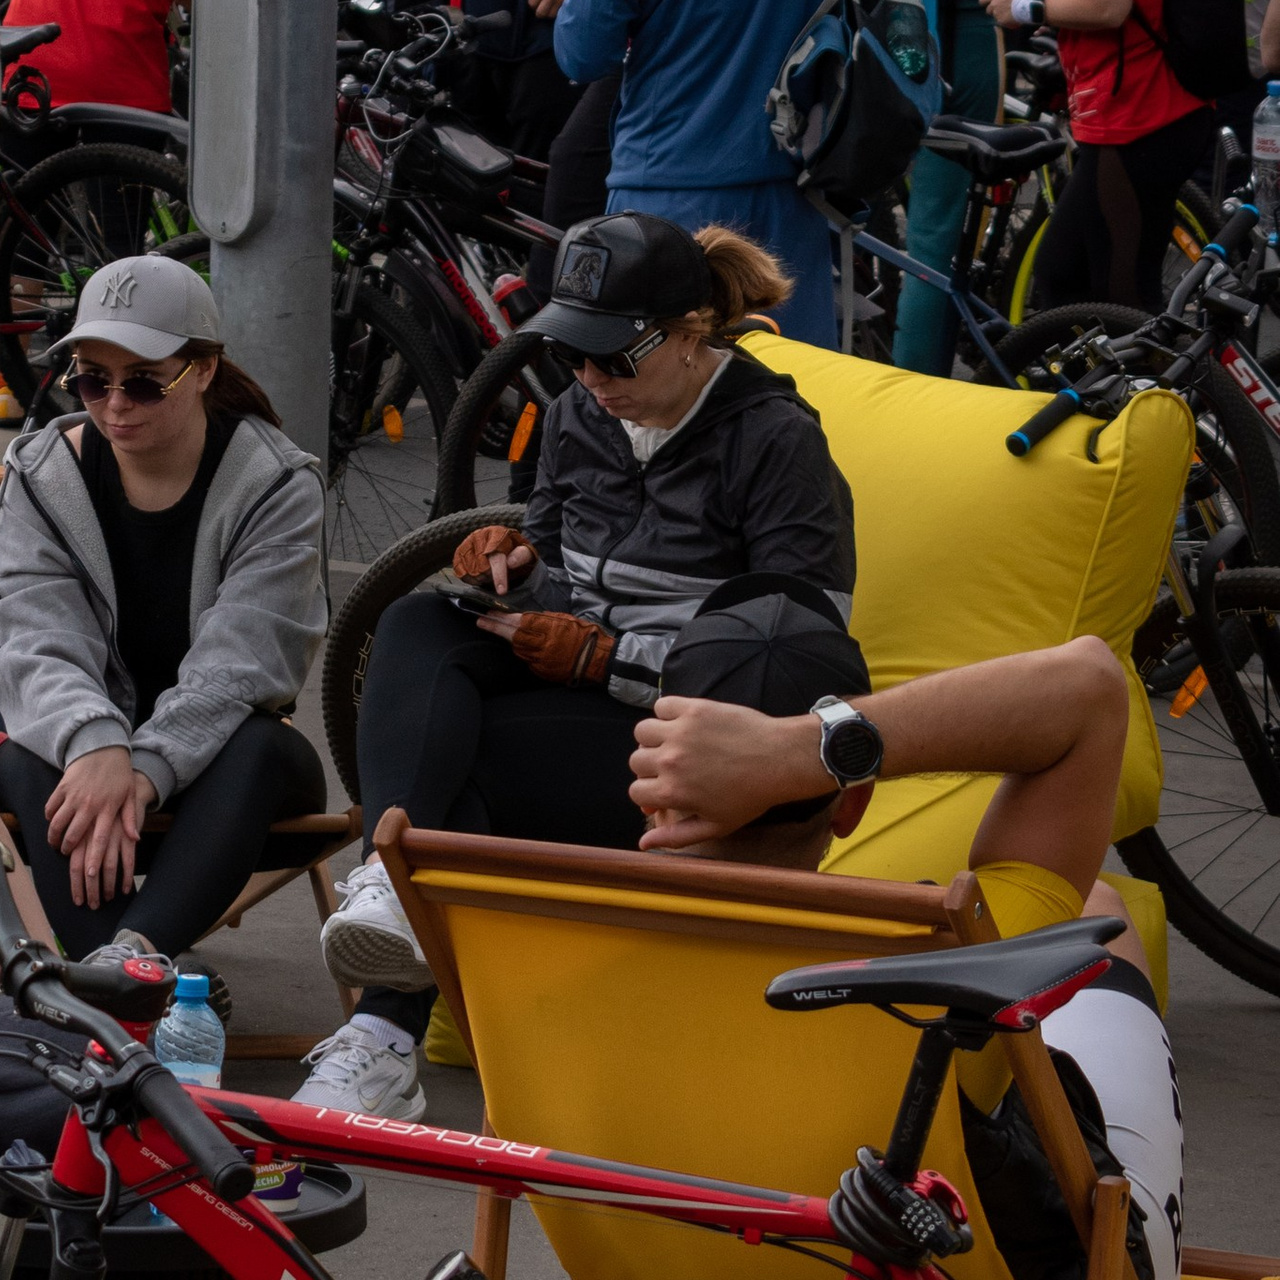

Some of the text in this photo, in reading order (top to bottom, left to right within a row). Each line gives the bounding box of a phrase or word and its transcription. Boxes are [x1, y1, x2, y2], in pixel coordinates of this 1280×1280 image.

[100, 271, 138, 309] NY
[793, 989, 852, 1001] WELT
[33, 1001, 70, 1024] WELT
[214, 1201, 254, 1231] DESIGN
